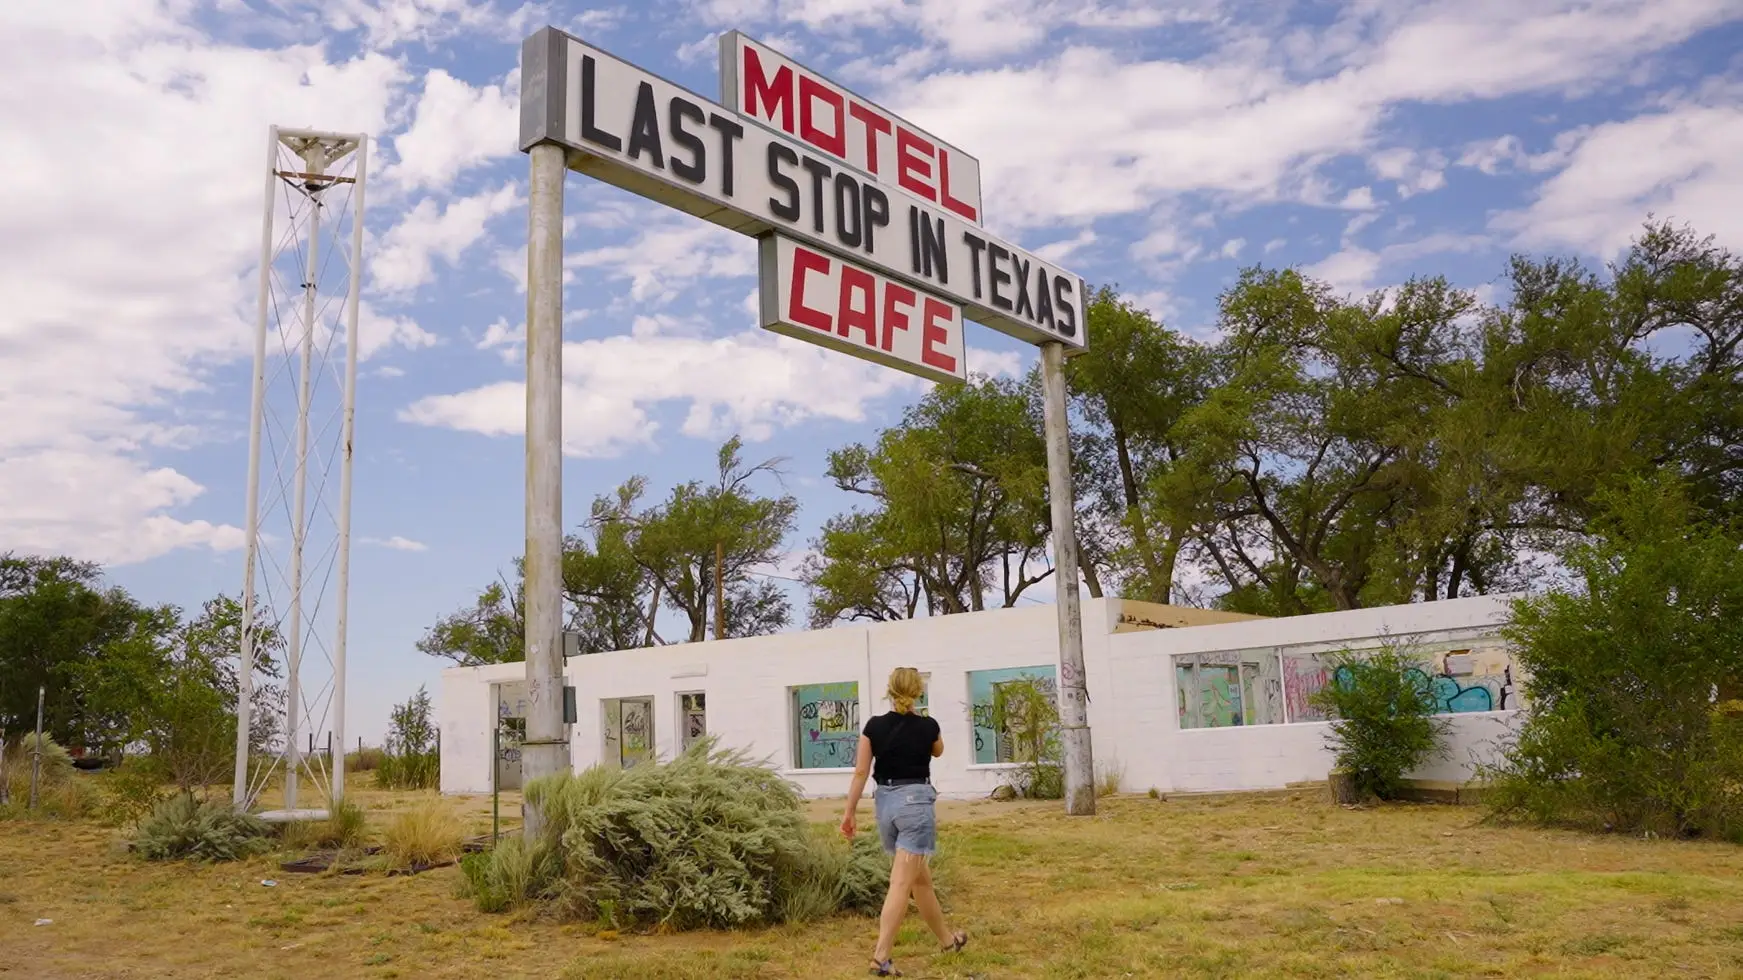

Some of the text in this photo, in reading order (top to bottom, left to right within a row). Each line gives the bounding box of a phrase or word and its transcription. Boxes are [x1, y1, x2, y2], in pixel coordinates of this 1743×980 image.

[581, 54, 1076, 338] LAST STOP IN TEXAS
[743, 45, 976, 221] MOTEL
[788, 246, 957, 373] CAFE
